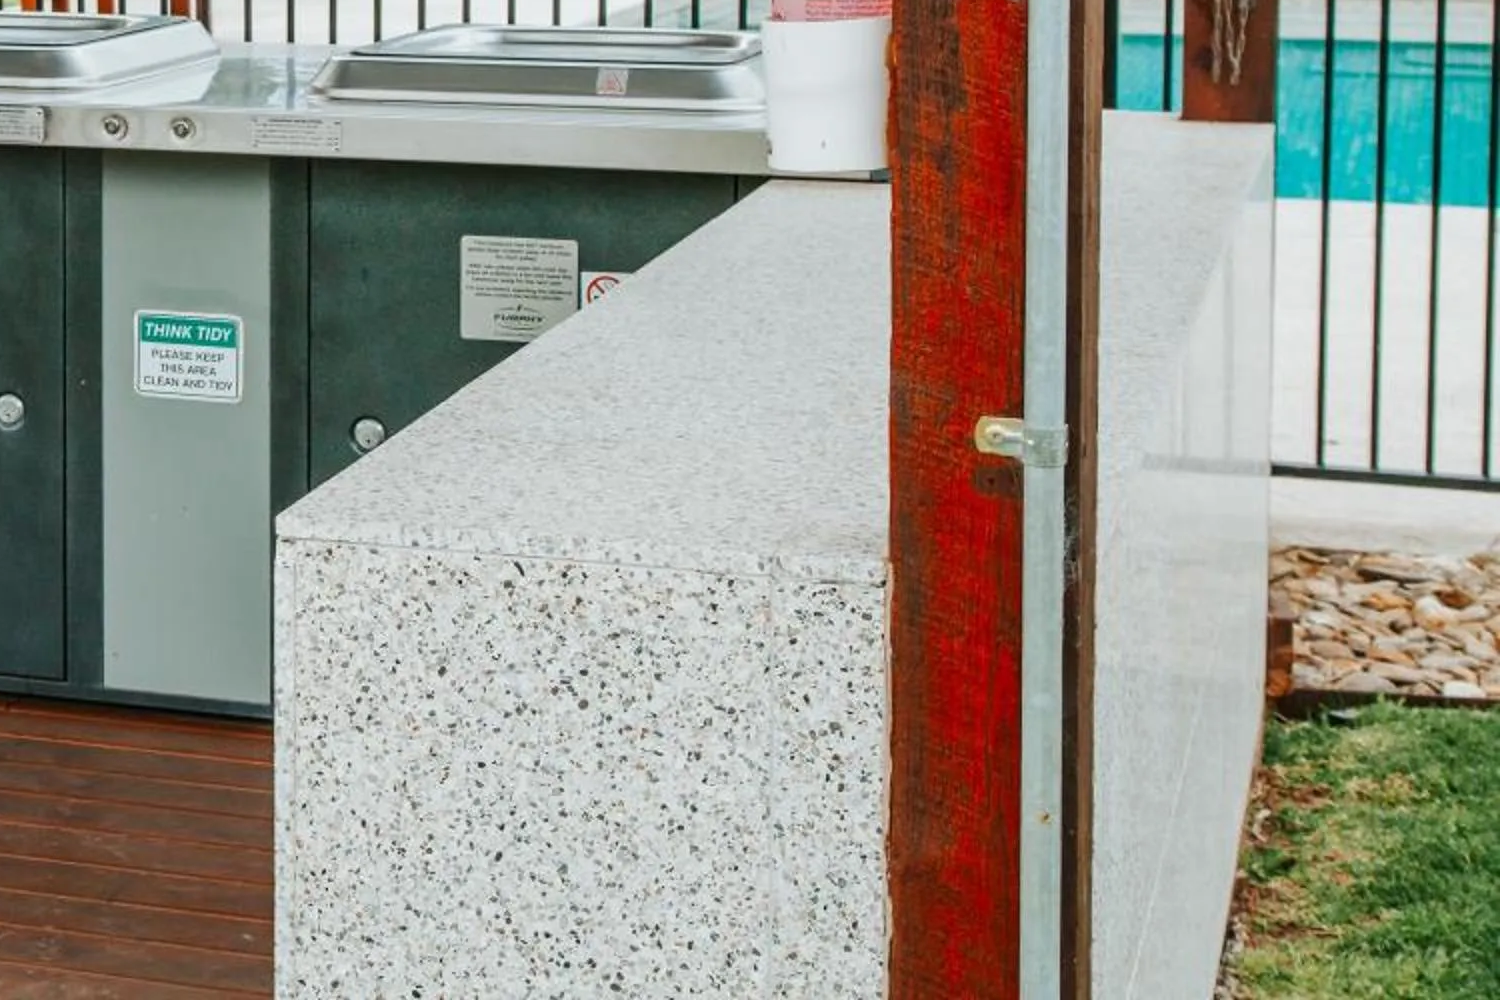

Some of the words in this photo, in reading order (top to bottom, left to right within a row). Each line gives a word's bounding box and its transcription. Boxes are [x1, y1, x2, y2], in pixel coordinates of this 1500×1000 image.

[145, 322, 193, 339] THINK
[196, 326, 233, 342] TIDY
[151, 348, 193, 361] PLEASE
[195, 351, 225, 363] KEEP
[160, 363, 185, 374] THIS
[187, 365, 217, 377] AREA
[143, 376, 179, 388] CLEAN
[182, 379, 206, 389] AND
[209, 380, 233, 391] TIDY
